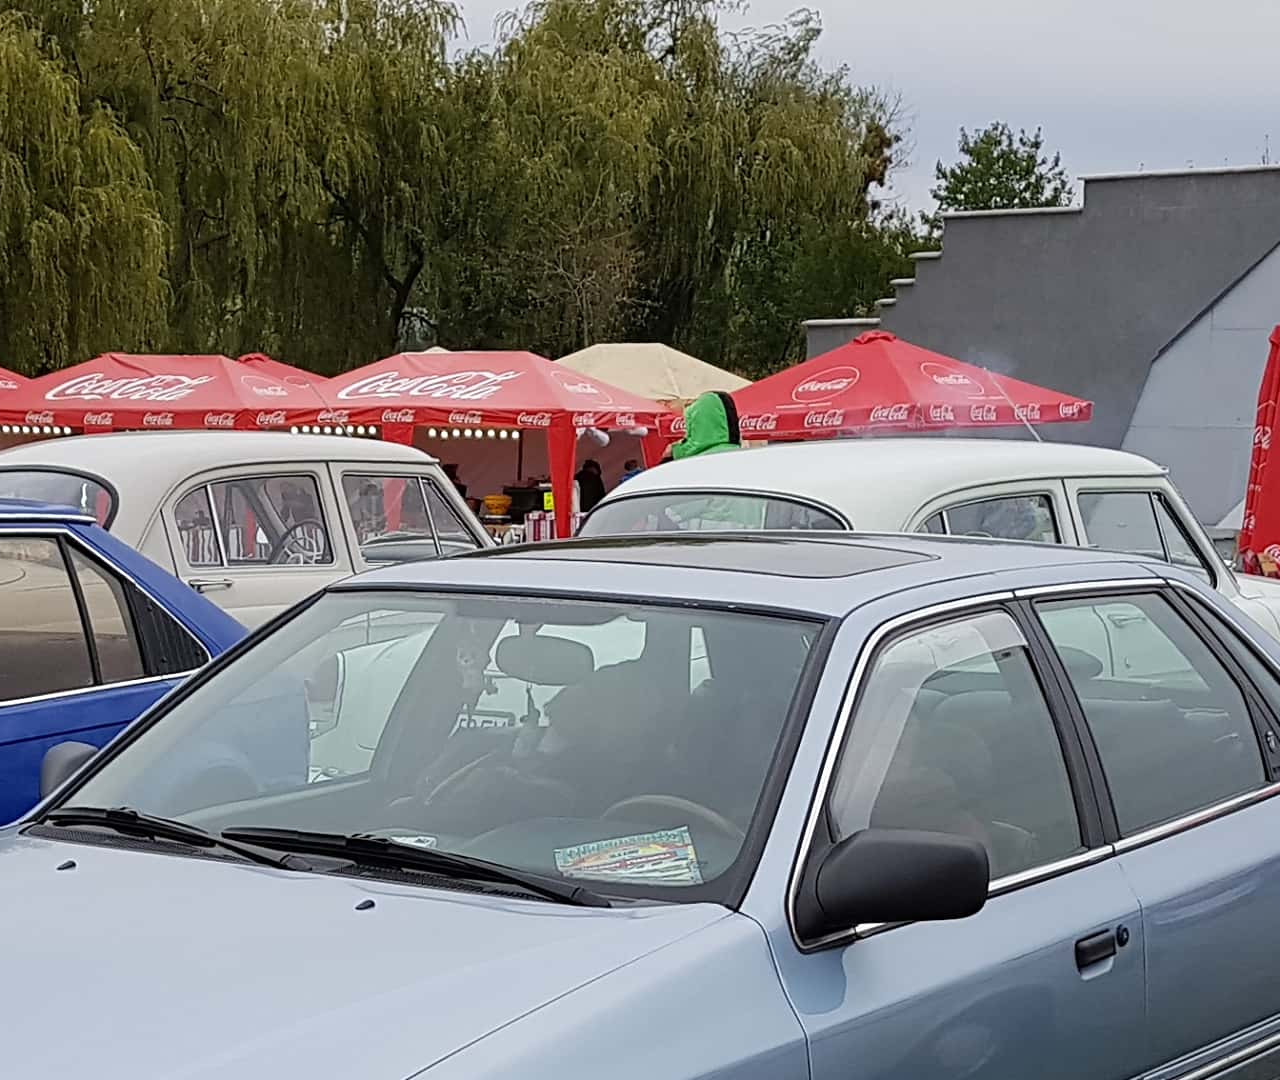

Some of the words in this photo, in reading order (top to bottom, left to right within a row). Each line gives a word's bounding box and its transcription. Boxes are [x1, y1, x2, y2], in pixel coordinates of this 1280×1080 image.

[45, 373, 216, 401] Coca-Cola
[337, 371, 527, 400] Coca-Cola
[739, 412, 779, 430] Coca-Cola
[804, 409, 845, 427] Coca-Cola
